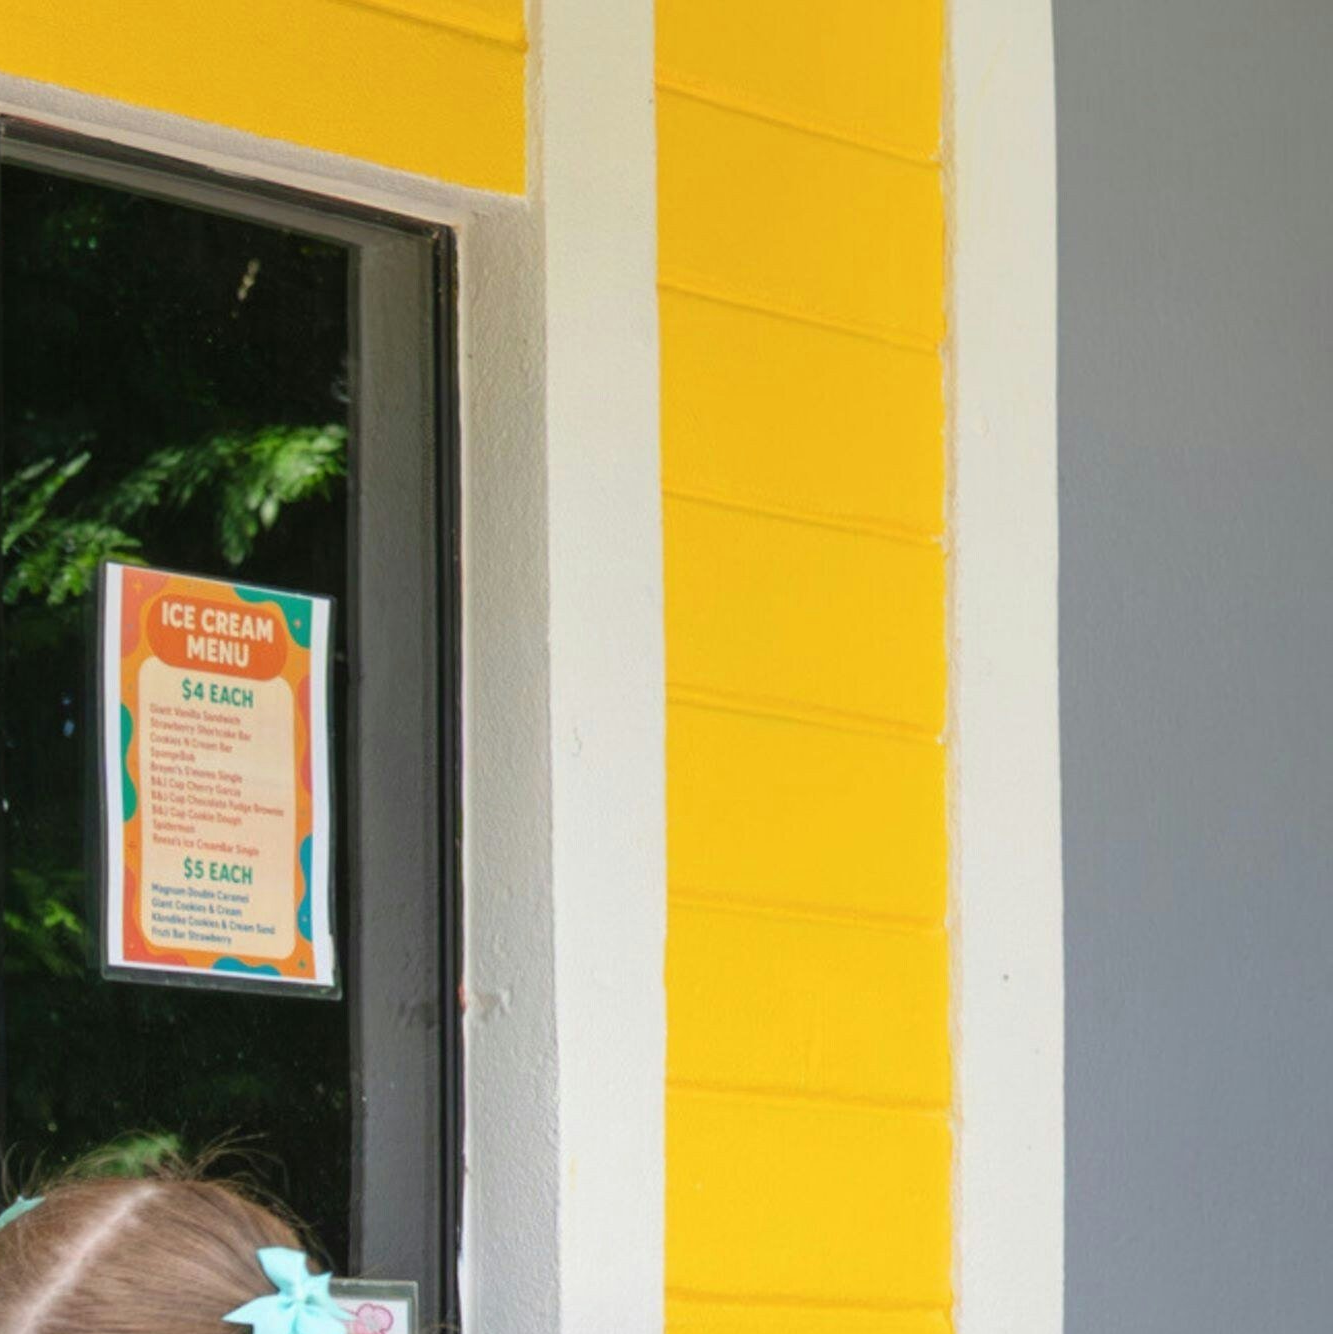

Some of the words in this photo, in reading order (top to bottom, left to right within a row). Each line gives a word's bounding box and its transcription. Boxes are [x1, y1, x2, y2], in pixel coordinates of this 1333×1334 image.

[161, 601, 196, 630] ICE
[201, 608, 274, 643] CREAM
[186, 635, 250, 668] MENU
[182, 678, 205, 702] $4
[210, 685, 254, 708] EACH
[150, 703, 173, 715] Giant
[175, 707, 201, 720] Vanilla
[203, 711, 241, 725] Sandwich
[150, 717, 195, 734] Strawberry
[197, 724, 236, 739] Shortcake
[239, 730, 252, 742] Bar
[150, 732, 181, 746] Cookies
[192, 739, 217, 750] Cream
[219, 742, 233, 753] Bar
[218, 770, 243, 783] Single
[169, 778, 184, 790] Cup
[187, 781, 214, 794] Cherry
[216, 785, 241, 798] Garcia
[170, 793, 185, 805] Cup
[187, 794, 227, 809] Chocolate
[229, 800, 252, 815] Fudge
[254, 803, 285, 817] Brownie
[170, 807, 185, 819] Cup
[188, 809, 214, 822] Cookie
[217, 812, 242, 827] Dough
[236, 843, 260, 857] Single
[183, 856, 205, 880] $5
[209, 862, 253, 885] EACH
[151, 882, 185, 896] Magnum
[188, 886, 214, 899] Double
[217, 890, 250, 903] Caramel
[151, 898, 173, 909] Giant
[175, 900, 206, 914] Cookies
[208, 903, 215, 914] &
[217, 905, 243, 917] Cream
[151, 912, 187, 926] Klondike
[188, 916, 218, 929] Cookies
[221, 919, 227, 930] &
[229, 921, 255, 933] Cream
[172, 928, 186, 939] Bar
[188, 930, 232, 945] Strawberry
